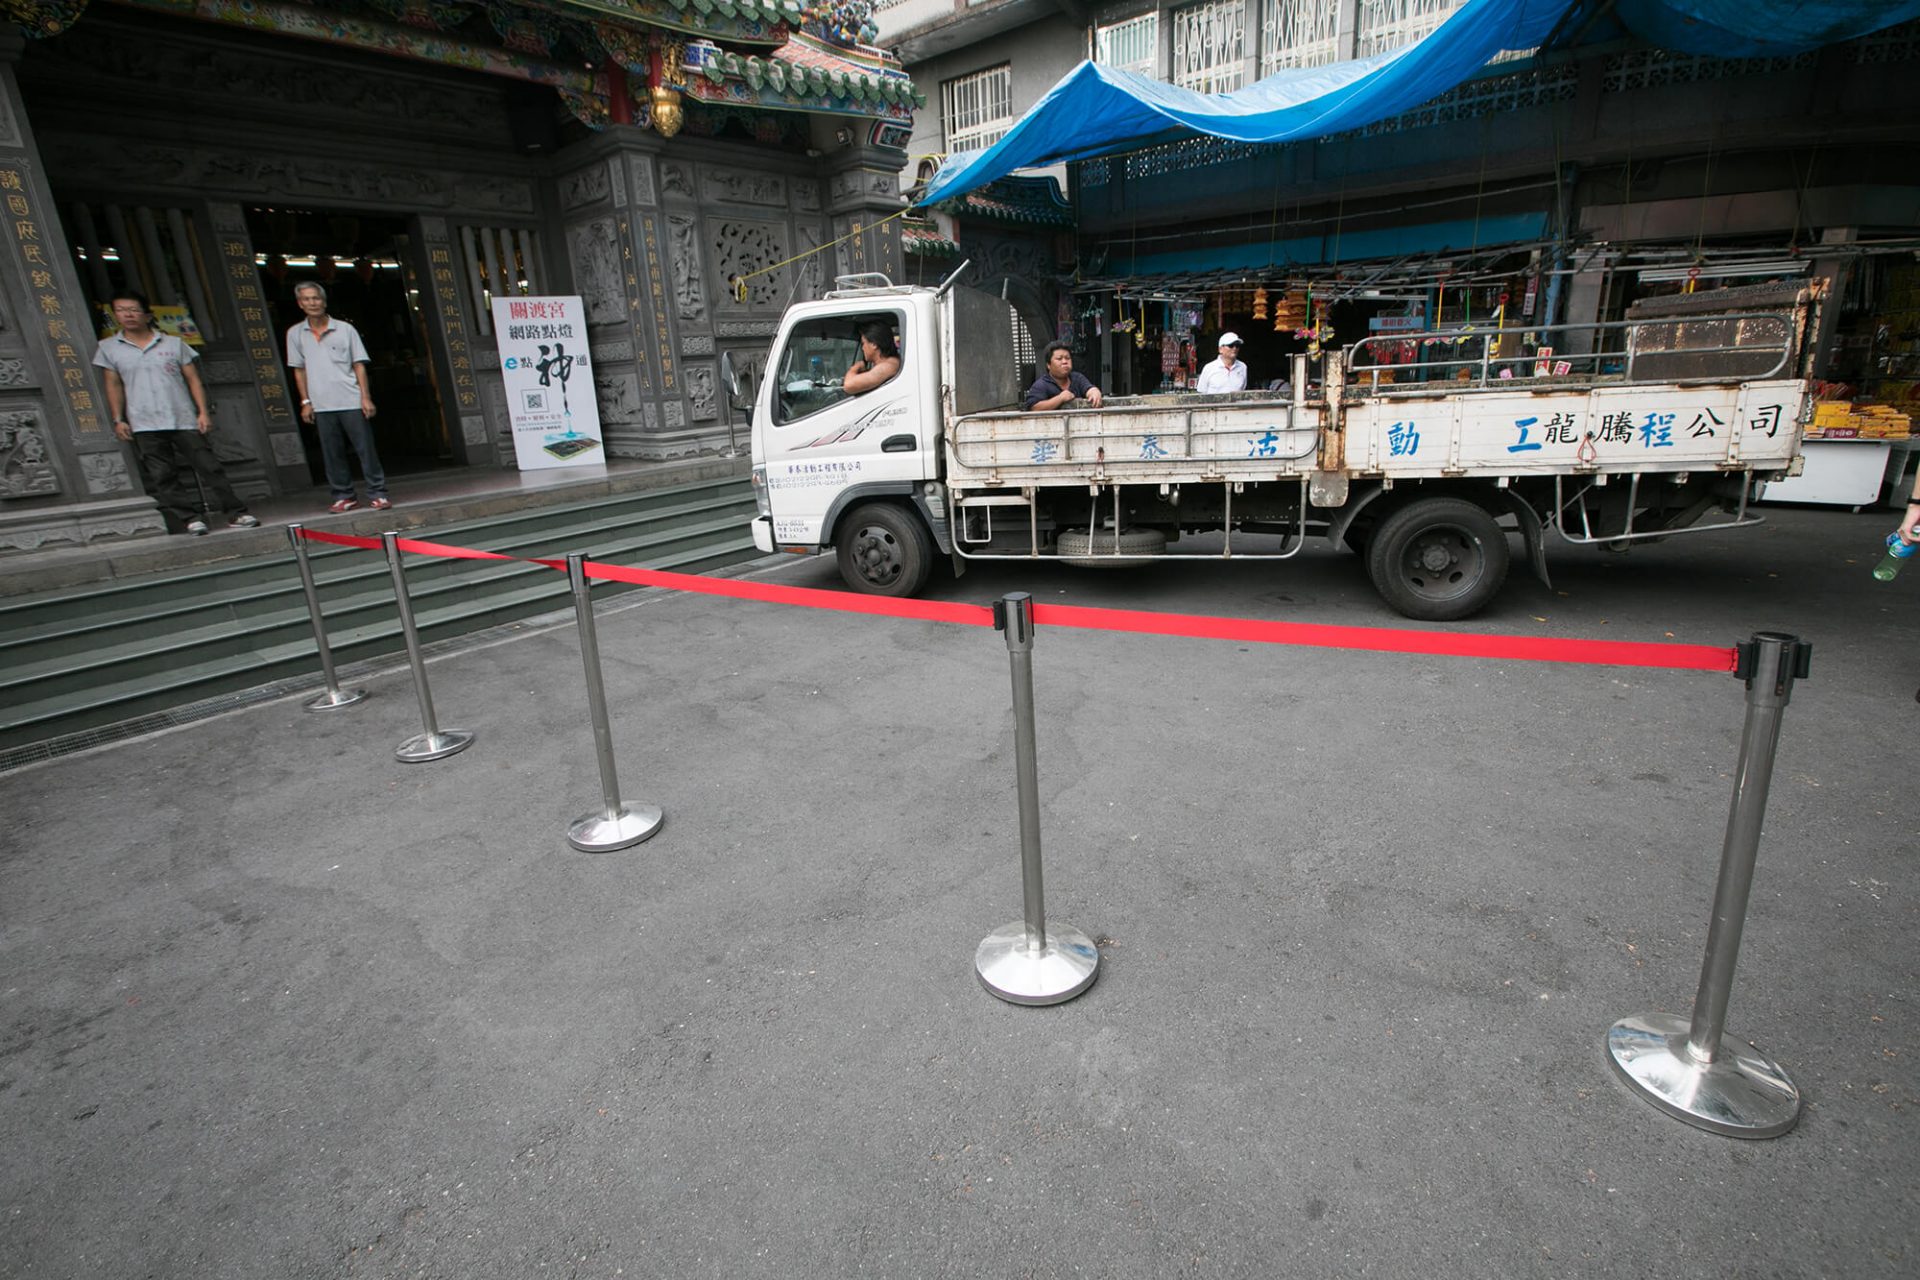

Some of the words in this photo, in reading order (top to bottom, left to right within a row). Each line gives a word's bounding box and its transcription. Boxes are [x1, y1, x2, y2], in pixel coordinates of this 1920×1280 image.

[509, 301, 565, 320] 關渡宮
[508, 323, 574, 340] 網路點燈
[1386, 421, 1421, 457] 動
